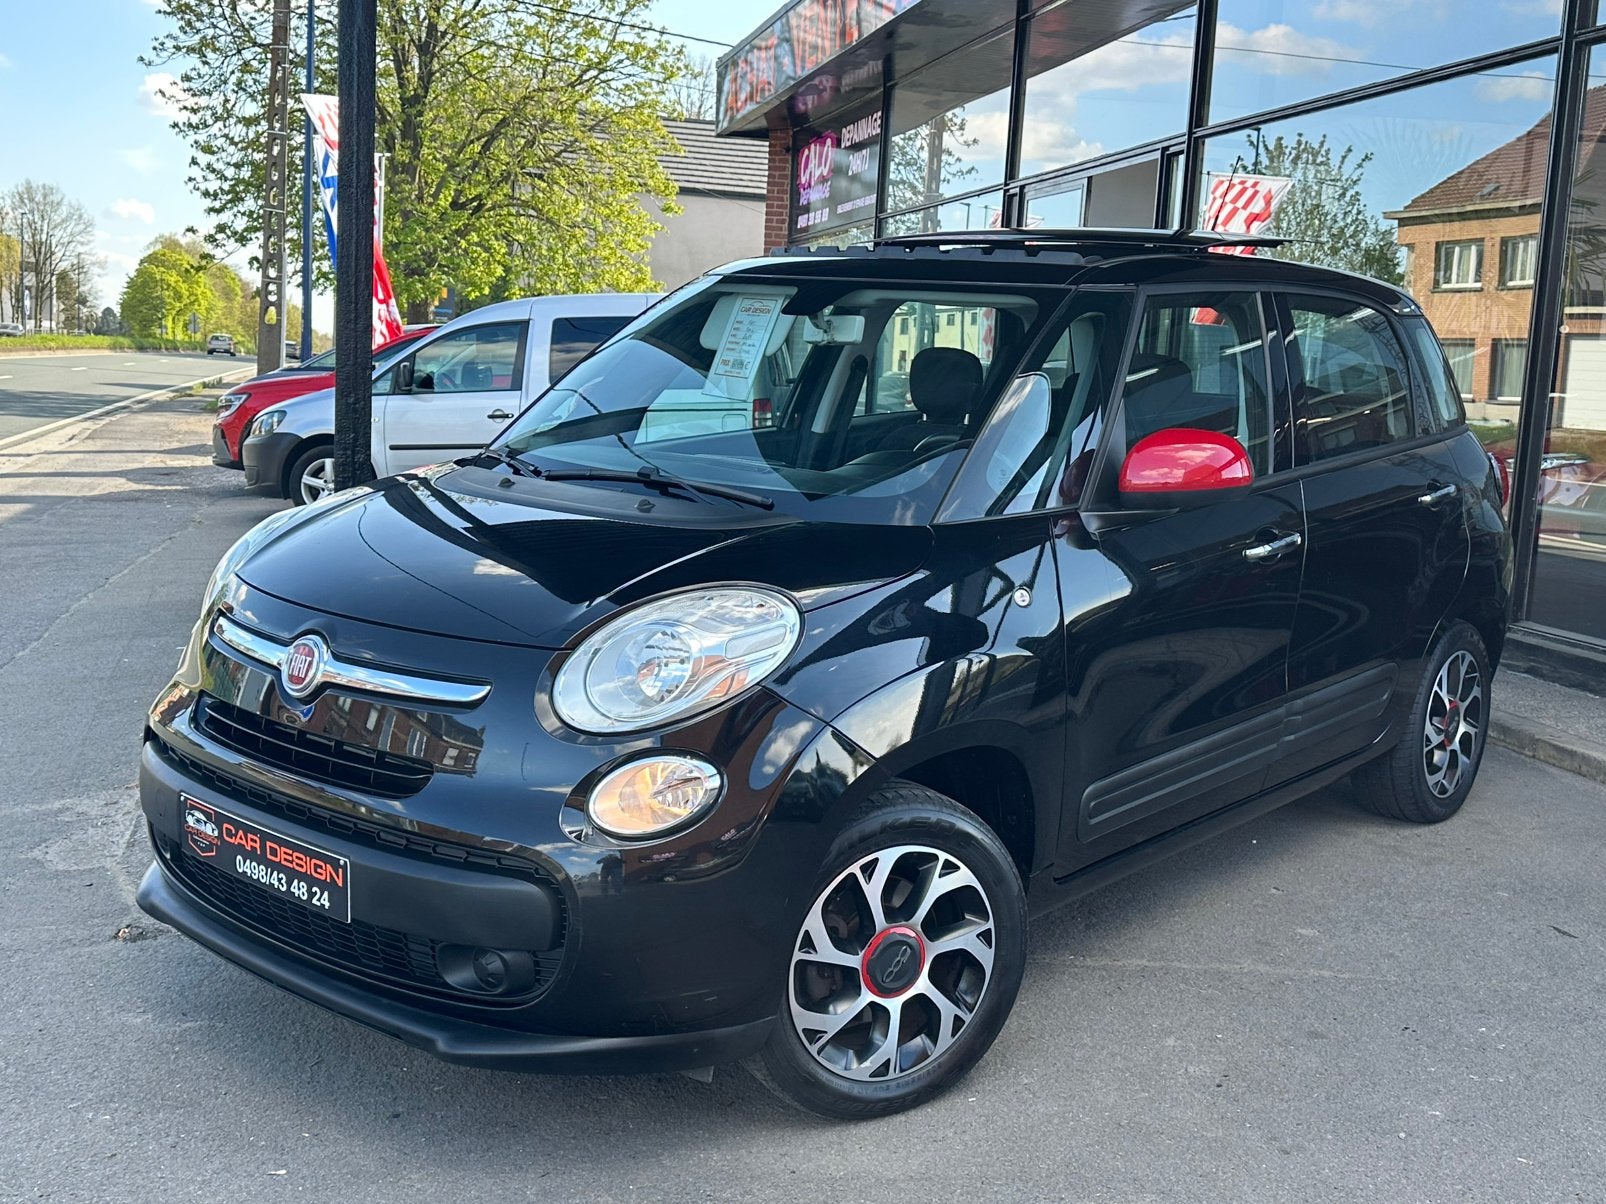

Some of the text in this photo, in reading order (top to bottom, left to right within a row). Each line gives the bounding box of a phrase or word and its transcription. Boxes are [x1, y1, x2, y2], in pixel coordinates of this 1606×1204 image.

[801, 138, 832, 187] CALO
[289, 654, 312, 678] FIAT
[222, 823, 343, 888] CAR DESIGN
[236, 855, 330, 910] 0498/43 48 24
